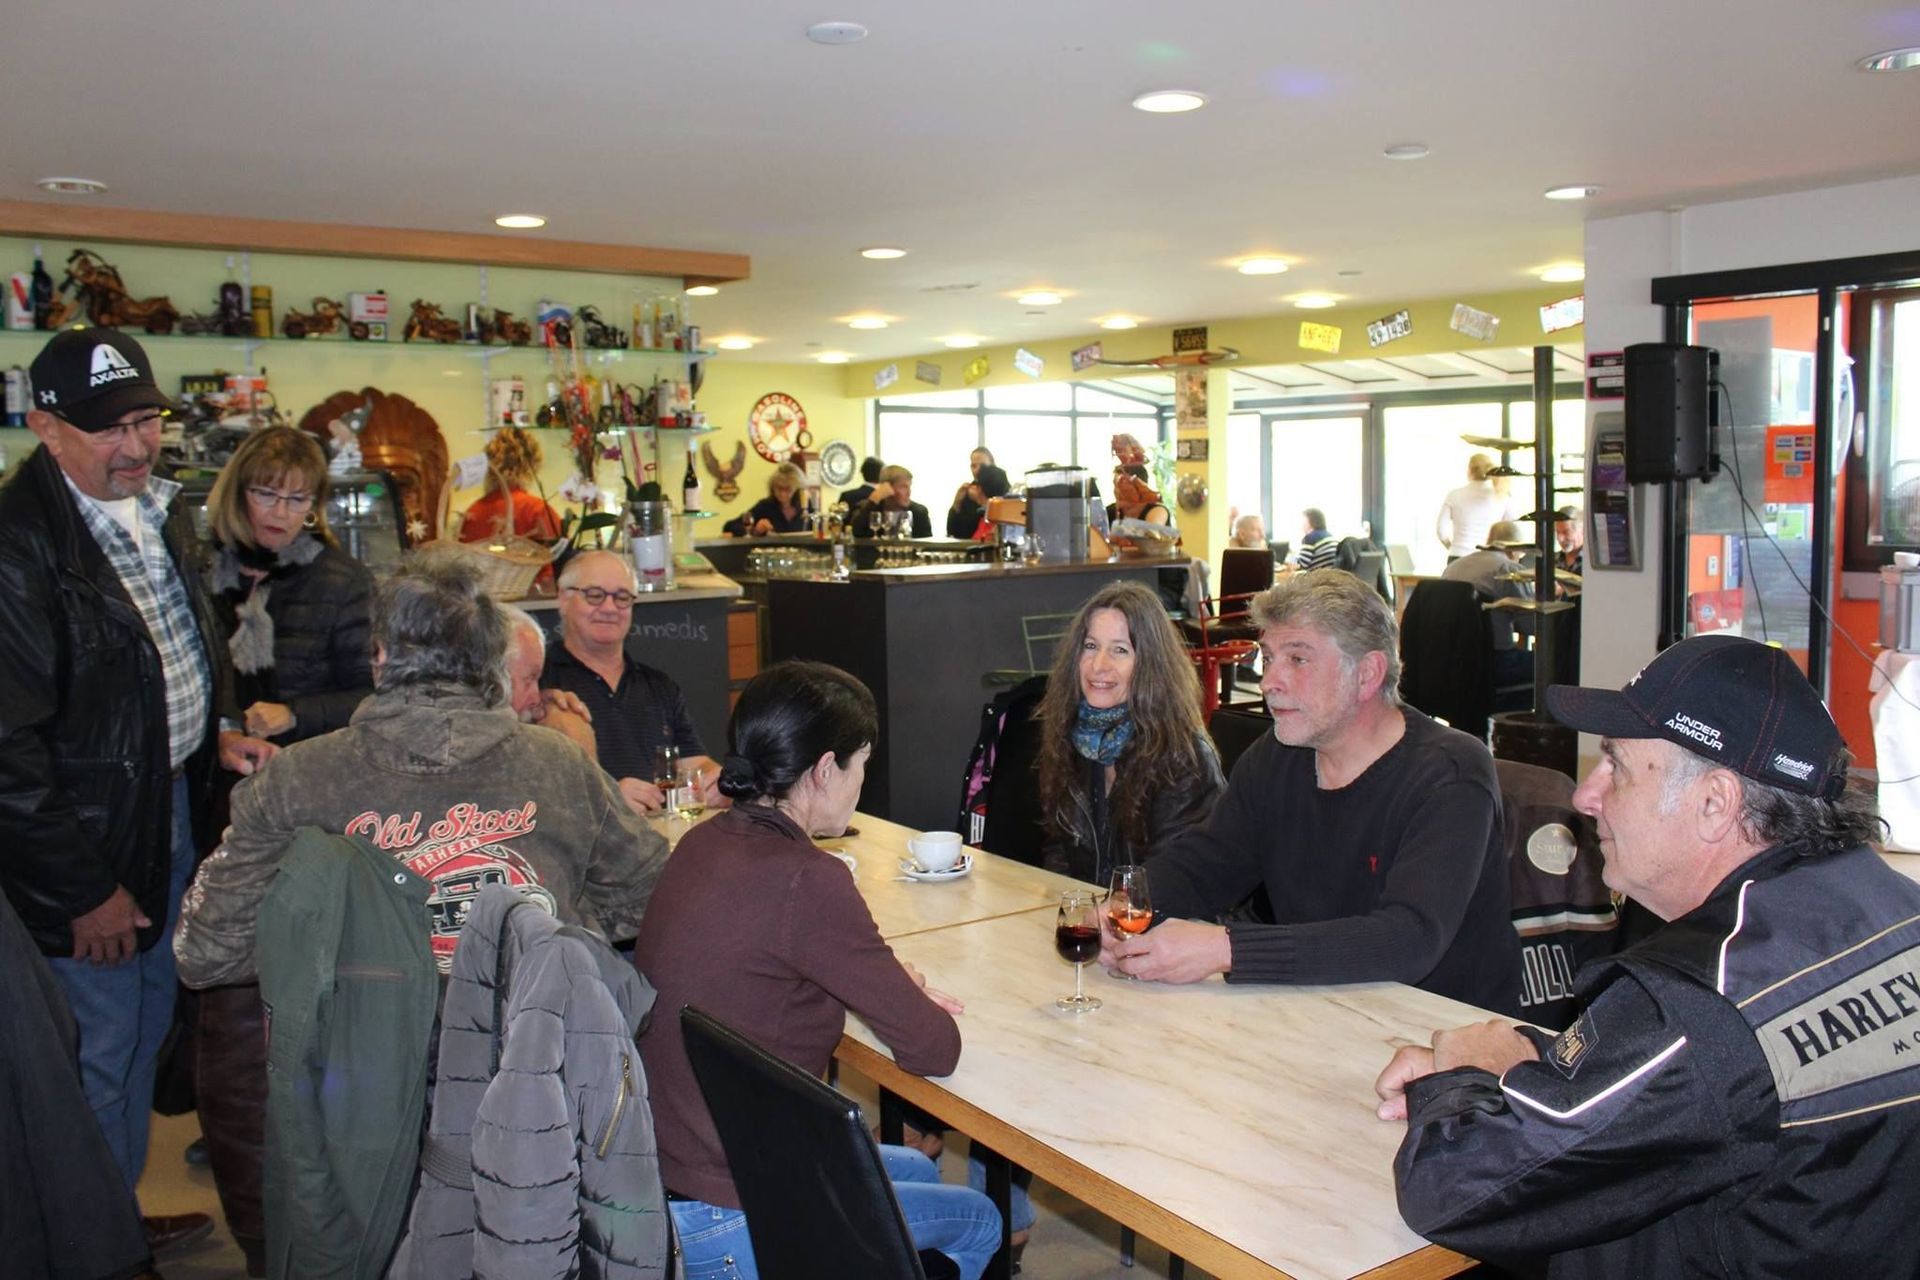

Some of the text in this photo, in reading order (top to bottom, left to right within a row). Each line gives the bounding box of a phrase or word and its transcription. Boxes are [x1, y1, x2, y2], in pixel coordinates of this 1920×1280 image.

[90, 368, 139, 387] AXALTA
[1665, 719, 1724, 751] ARMOUR
[1675, 711, 1721, 739] UNDER
[345, 801, 537, 849] Old Skool
[406, 839, 481, 871] ARHEAD
[1780, 972, 1920, 1067] HARLEY
